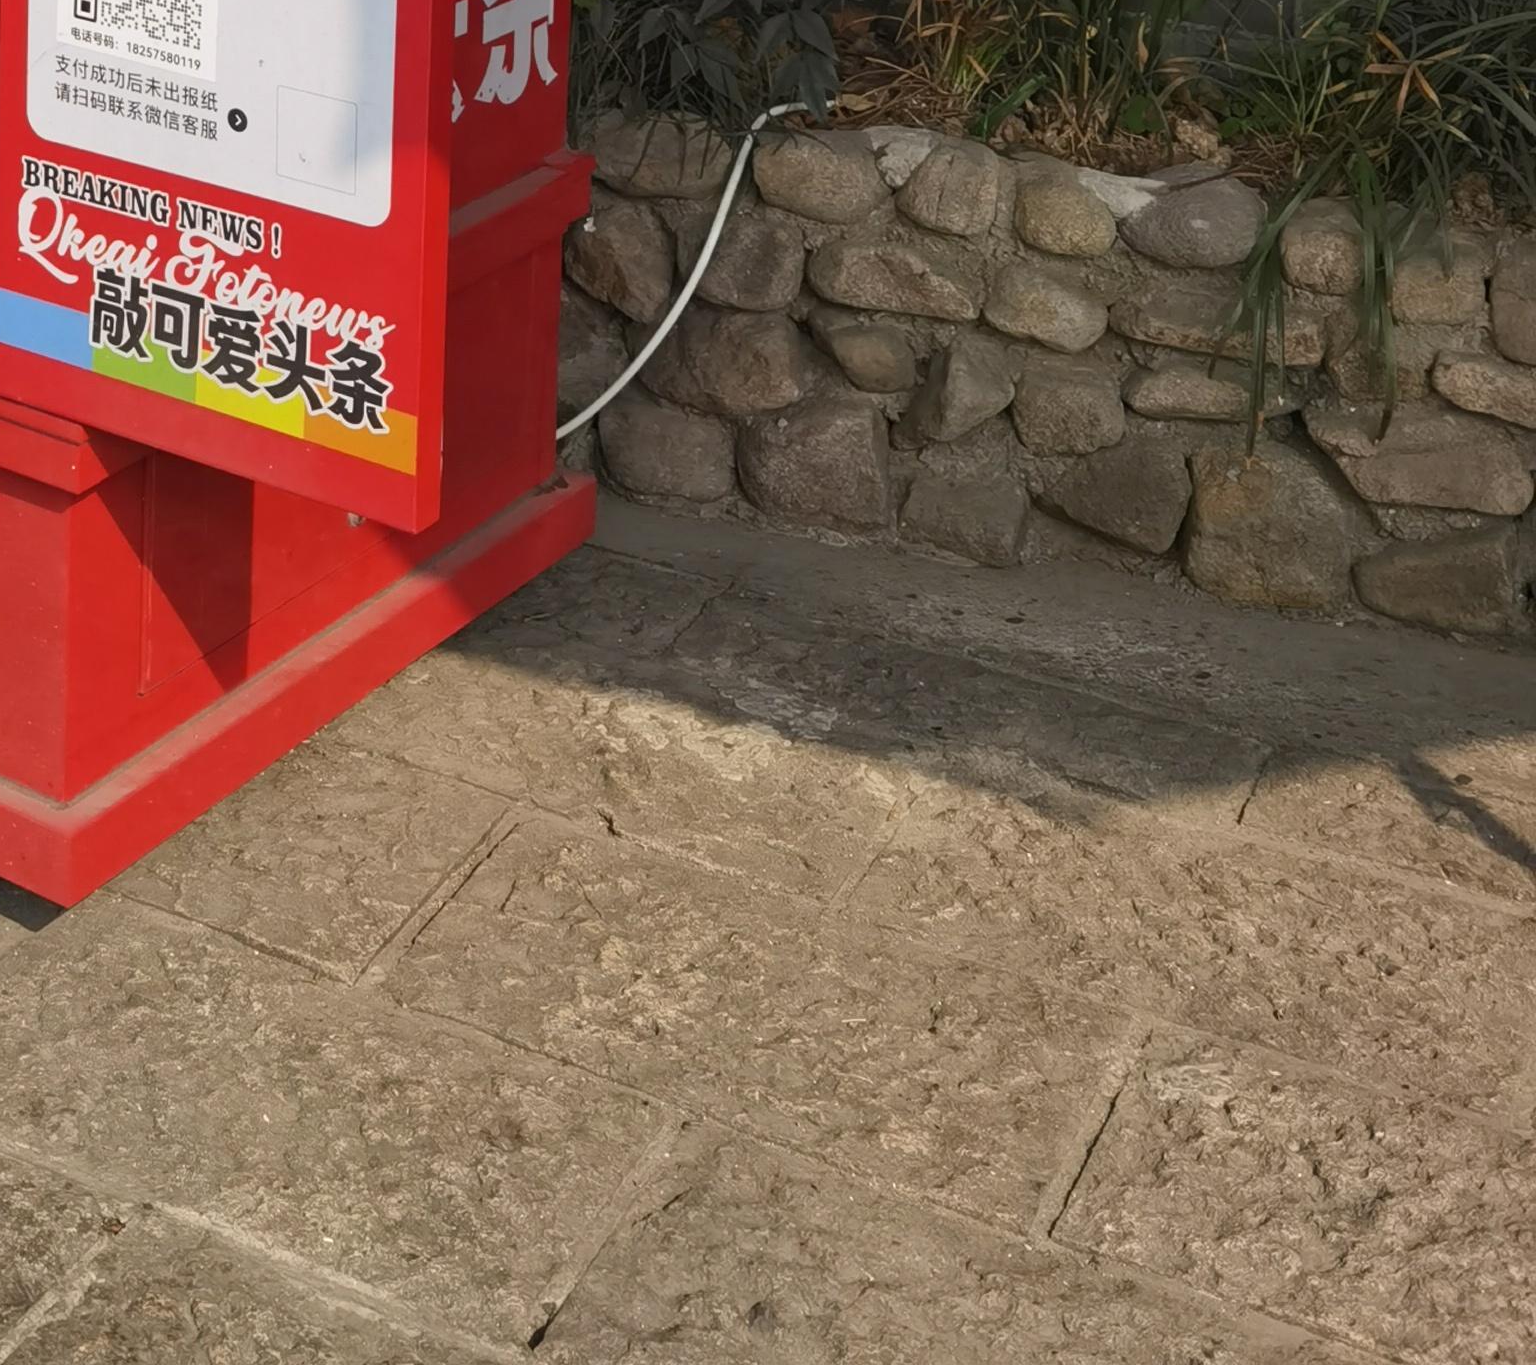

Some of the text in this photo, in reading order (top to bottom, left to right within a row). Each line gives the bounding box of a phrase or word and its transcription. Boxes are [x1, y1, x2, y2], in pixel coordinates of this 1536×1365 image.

[55, 54, 219, 113] 支付成功后未出报纸
[126, 41, 202, 71] 18257580119
[54, 81, 219, 142] 请扫码联系微信客服
[22, 156, 171, 227] BREAKING
[178, 200, 263, 250] NEWS
[90, 263, 391, 431] 敲可爱头条
